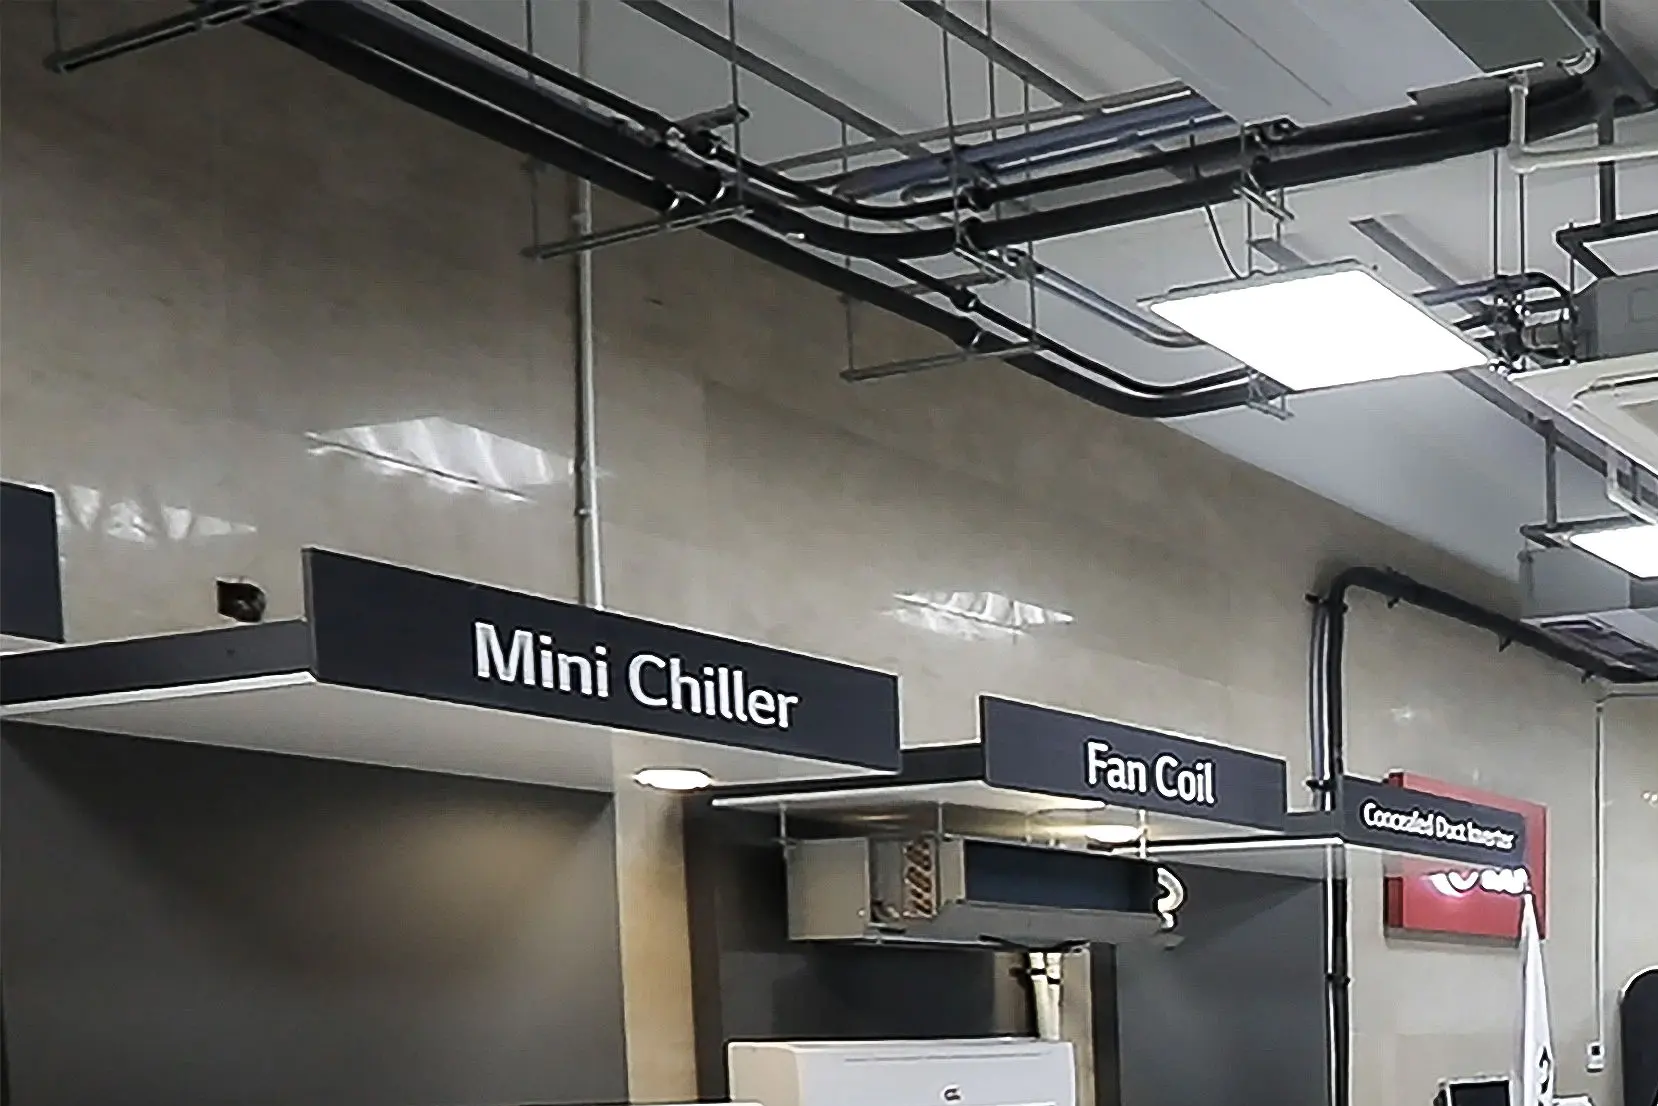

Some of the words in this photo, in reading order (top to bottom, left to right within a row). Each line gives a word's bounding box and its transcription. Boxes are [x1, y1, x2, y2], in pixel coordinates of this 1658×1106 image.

[474, 621, 609, 698] Mini
[628, 653, 799, 729] Chiller
[1087, 740, 1148, 793] Fan
[1155, 754, 1215, 804] Coil
[1363, 801, 1434, 837] Concealed
[1435, 814, 1467, 842] Duct
